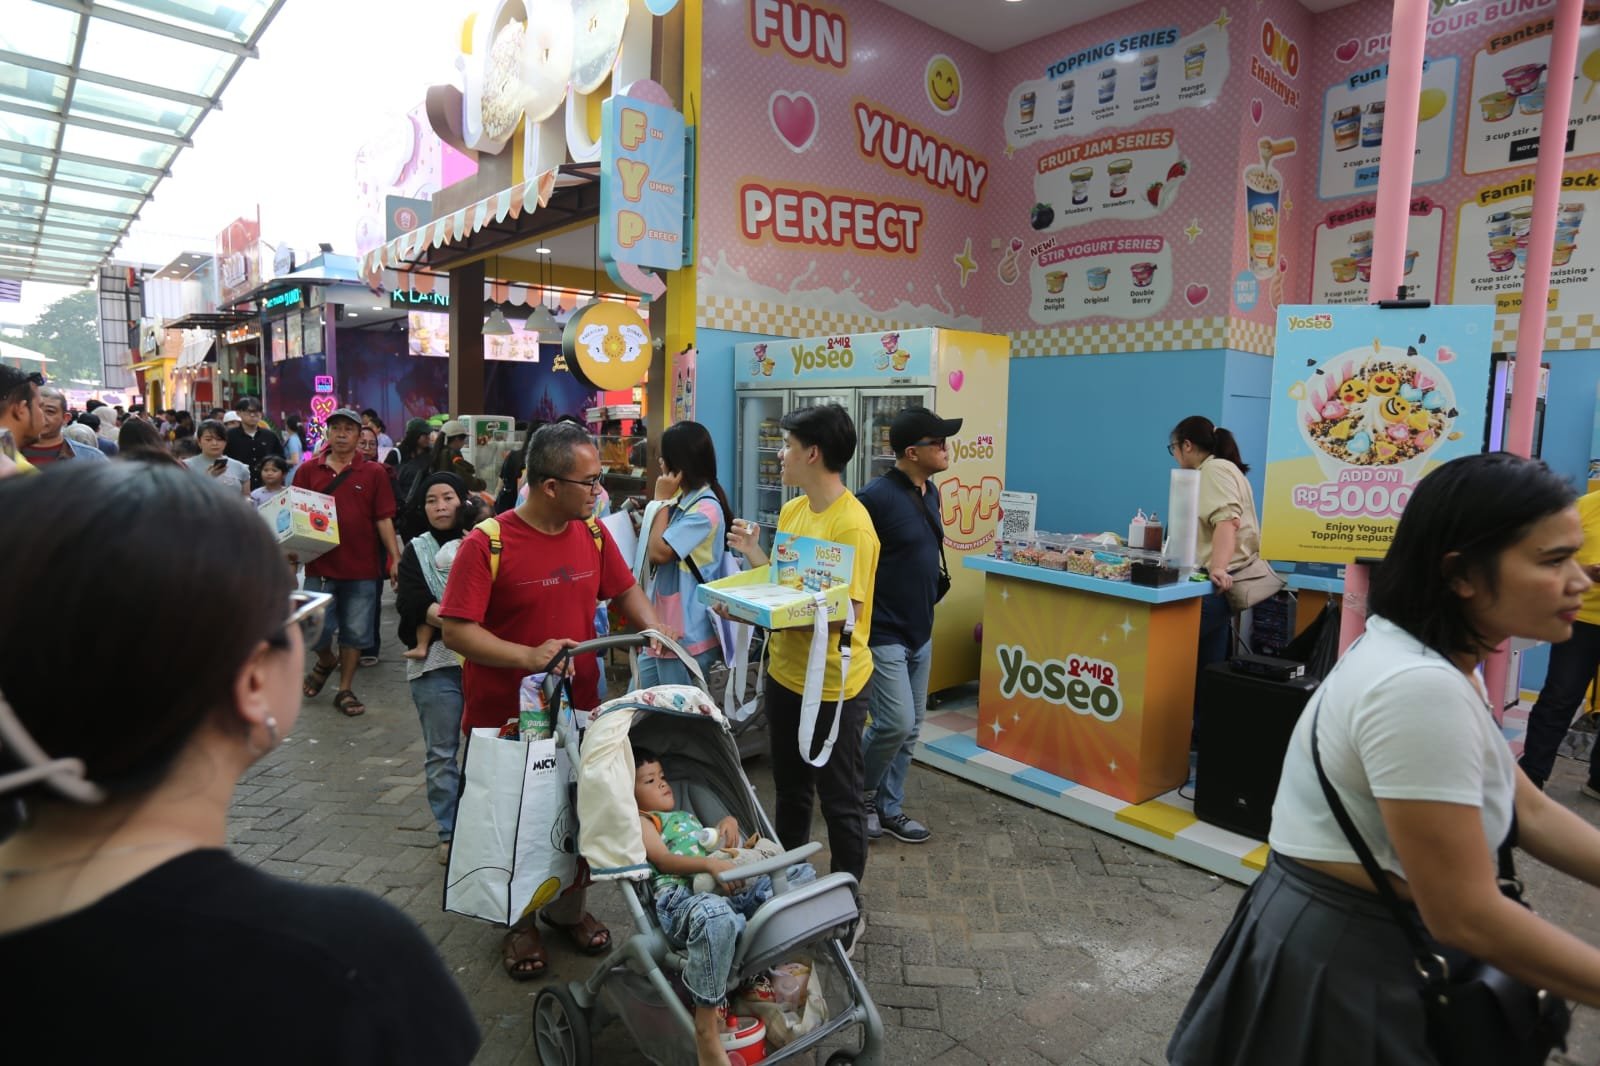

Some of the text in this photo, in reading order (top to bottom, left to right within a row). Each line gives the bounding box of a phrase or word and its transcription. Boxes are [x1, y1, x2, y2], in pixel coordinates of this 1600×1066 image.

[753, 0, 845, 65] FUN
[1490, 19, 1554, 50] Fantas
[1047, 29, 1177, 79] TOPPING SERIES
[1262, 21, 1299, 78] OMO
[1350, 69, 1380, 87] Fun
[1492, 131, 1510, 140] cup
[1512, 128, 1529, 136] stir
[856, 106, 988, 201] YUMMY
[1040, 132, 1170, 170] FRUIT JAM SERIES
[1480, 174, 1598, 203] Famil ack
[1064, 206, 1092, 215] Blueberry
[1102, 199, 1135, 208] Strawberry
[742, 188, 921, 250] PERFECT
[1328, 206, 1376, 224] Festiv
[1030, 238, 1056, 257] NEW!
[1041, 239, 1160, 264] STIR YOGURT SERIES
[1084, 296, 1109, 305] Original
[1130, 289, 1154, 297] Double
[1132, 297, 1151, 305] Berry
[1498, 300, 1510, 308] Rp
[827, 337, 851, 349] 요세요
[1341, 470, 1398, 482] ADD ON
[940, 476, 1003, 534] FYP
[1312, 531, 1394, 543] Topping sepuas
[1326, 523, 1394, 534] Enjoy Yogurt
[1068, 658, 1114, 687] 요세요
[532, 758, 556, 771] MICK
